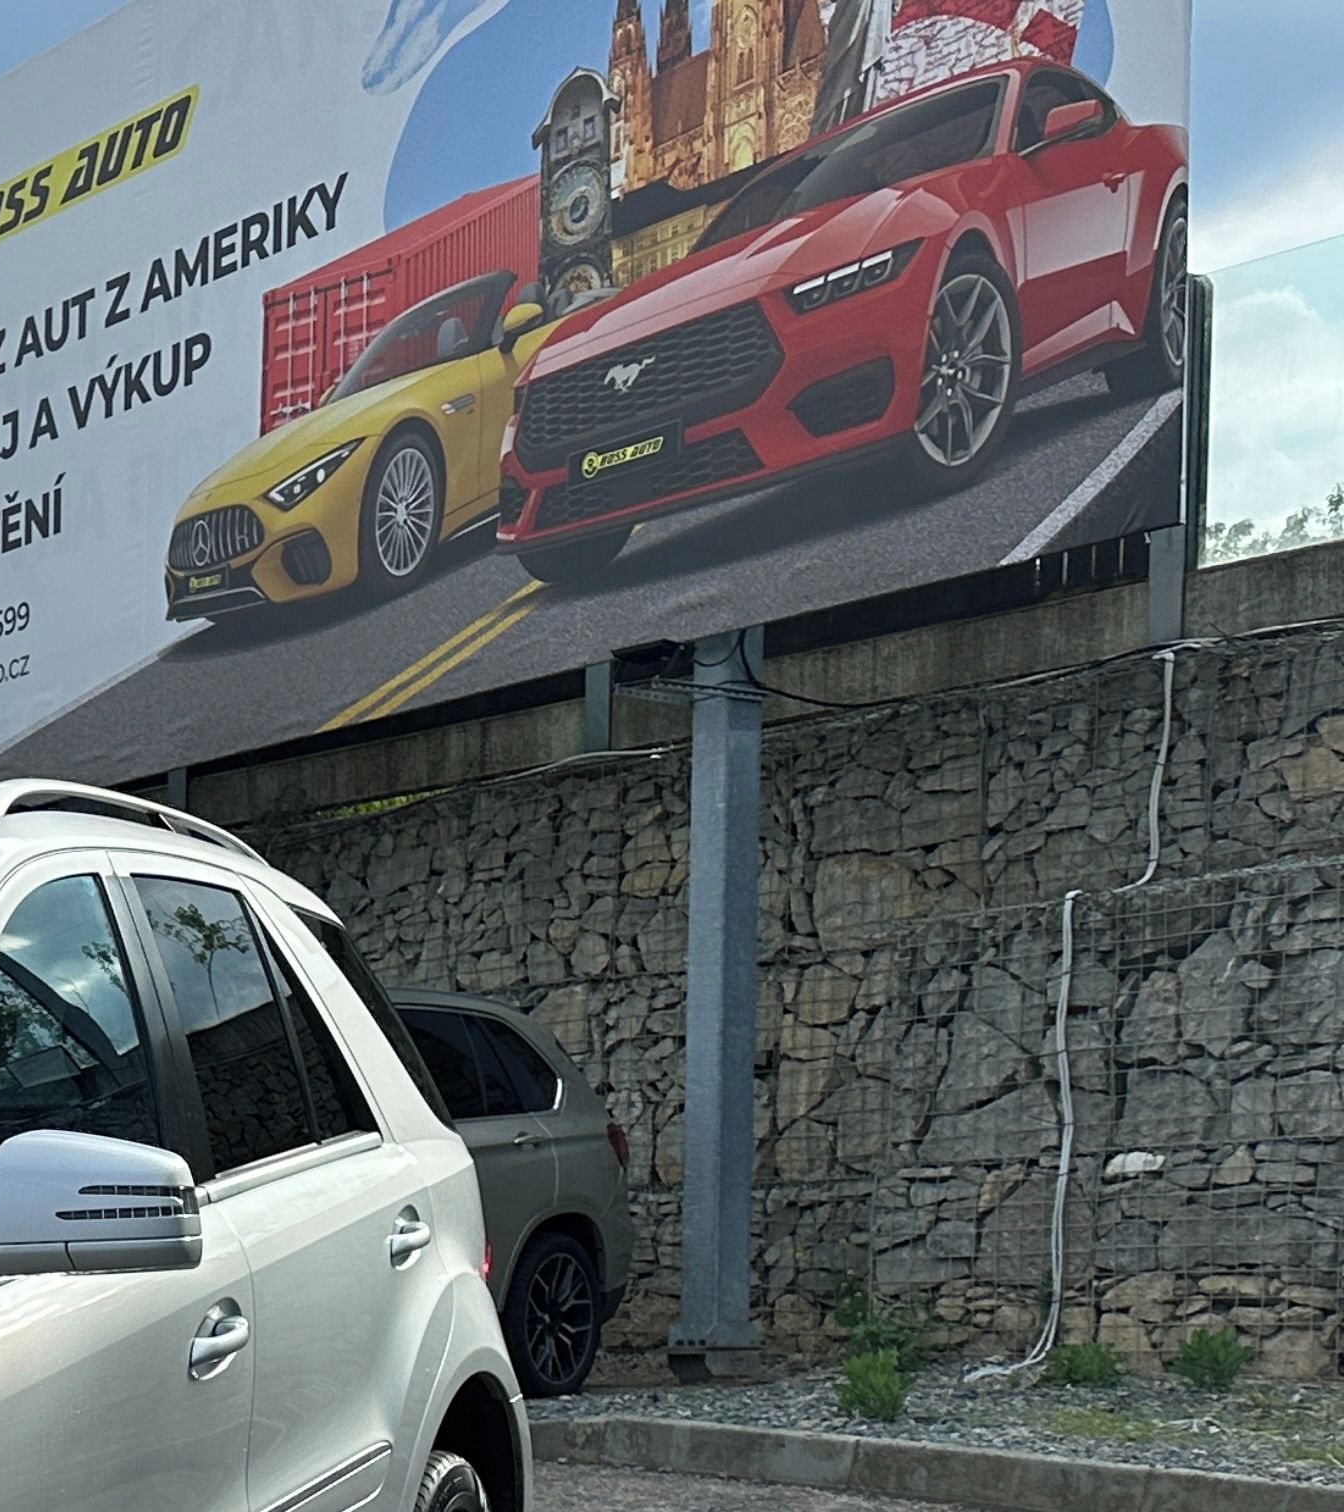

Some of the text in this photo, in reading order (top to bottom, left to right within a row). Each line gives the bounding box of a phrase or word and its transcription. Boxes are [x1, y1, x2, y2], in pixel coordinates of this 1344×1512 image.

[59, 95, 192, 206] AUTO
[14, 288, 96, 368] AUT
[104, 272, 131, 328] Z
[139, 172, 349, 314] AMERIKY
[29, 397, 59, 449] A
[68, 332, 212, 430] VÝKUP
